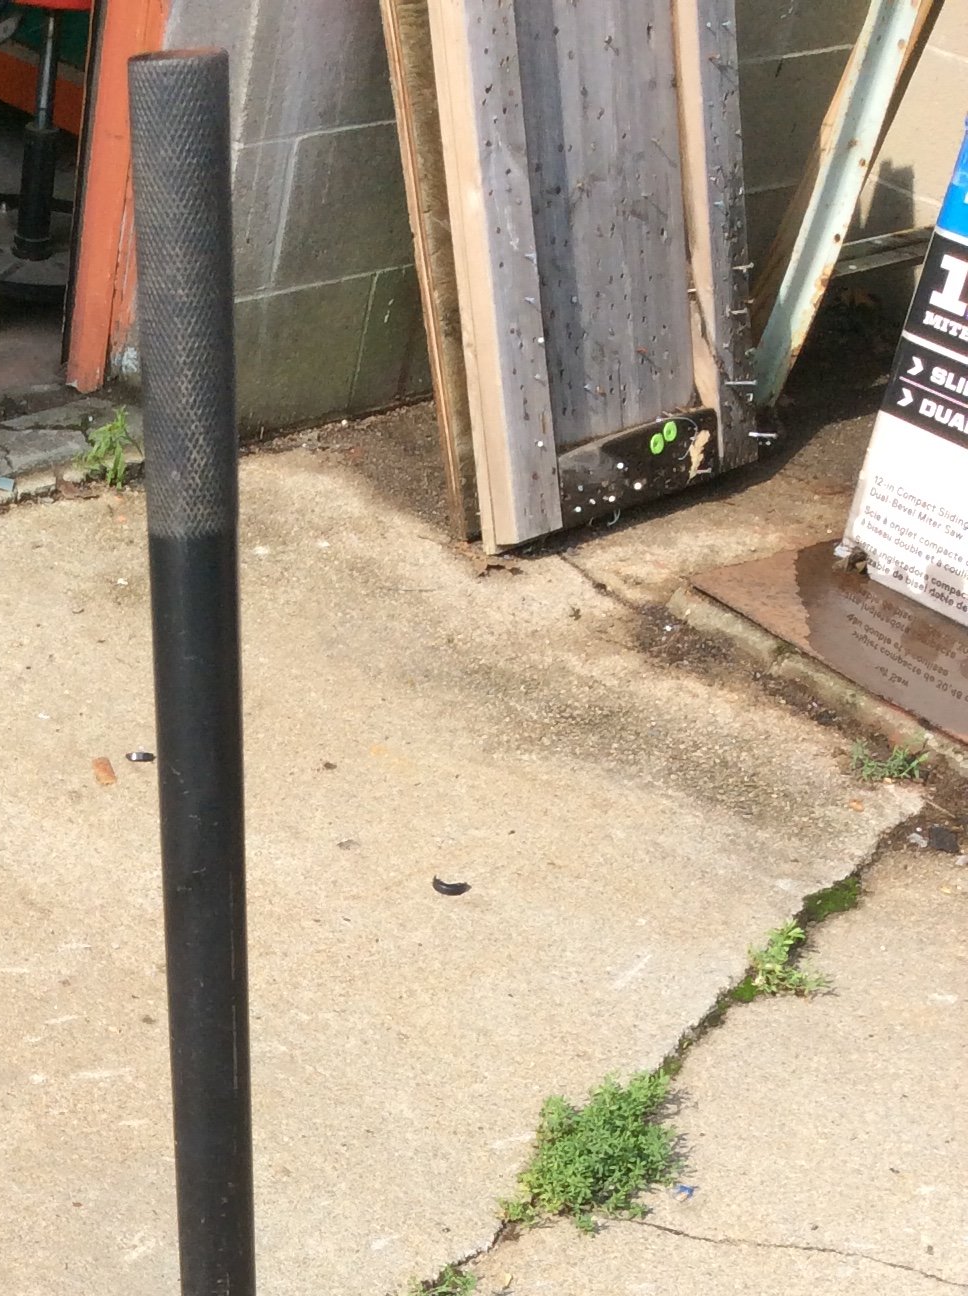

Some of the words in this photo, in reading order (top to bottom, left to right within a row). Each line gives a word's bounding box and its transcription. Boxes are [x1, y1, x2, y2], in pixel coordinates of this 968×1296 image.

[869, 487, 916, 516] Dual-Bevel
[917, 511, 942, 529] Miter
[944, 524, 964, 541] Saw
[896, 486, 937, 513] Compact
[938, 507, 968, 531] Sliding
[864, 505, 881, 521] Scie
[889, 521, 918, 540] onglet
[919, 536, 964, 563] compacte
[866, 520, 892, 542] biseau
[894, 537, 923, 558] double
[925, 552, 935, 564] et
[892, 570, 904, 581] de
[905, 574, 928, 593] bisel
[929, 587, 954, 606] doble
[956, 598, 968, 613] de
[930, 576, 968, 599] compac
